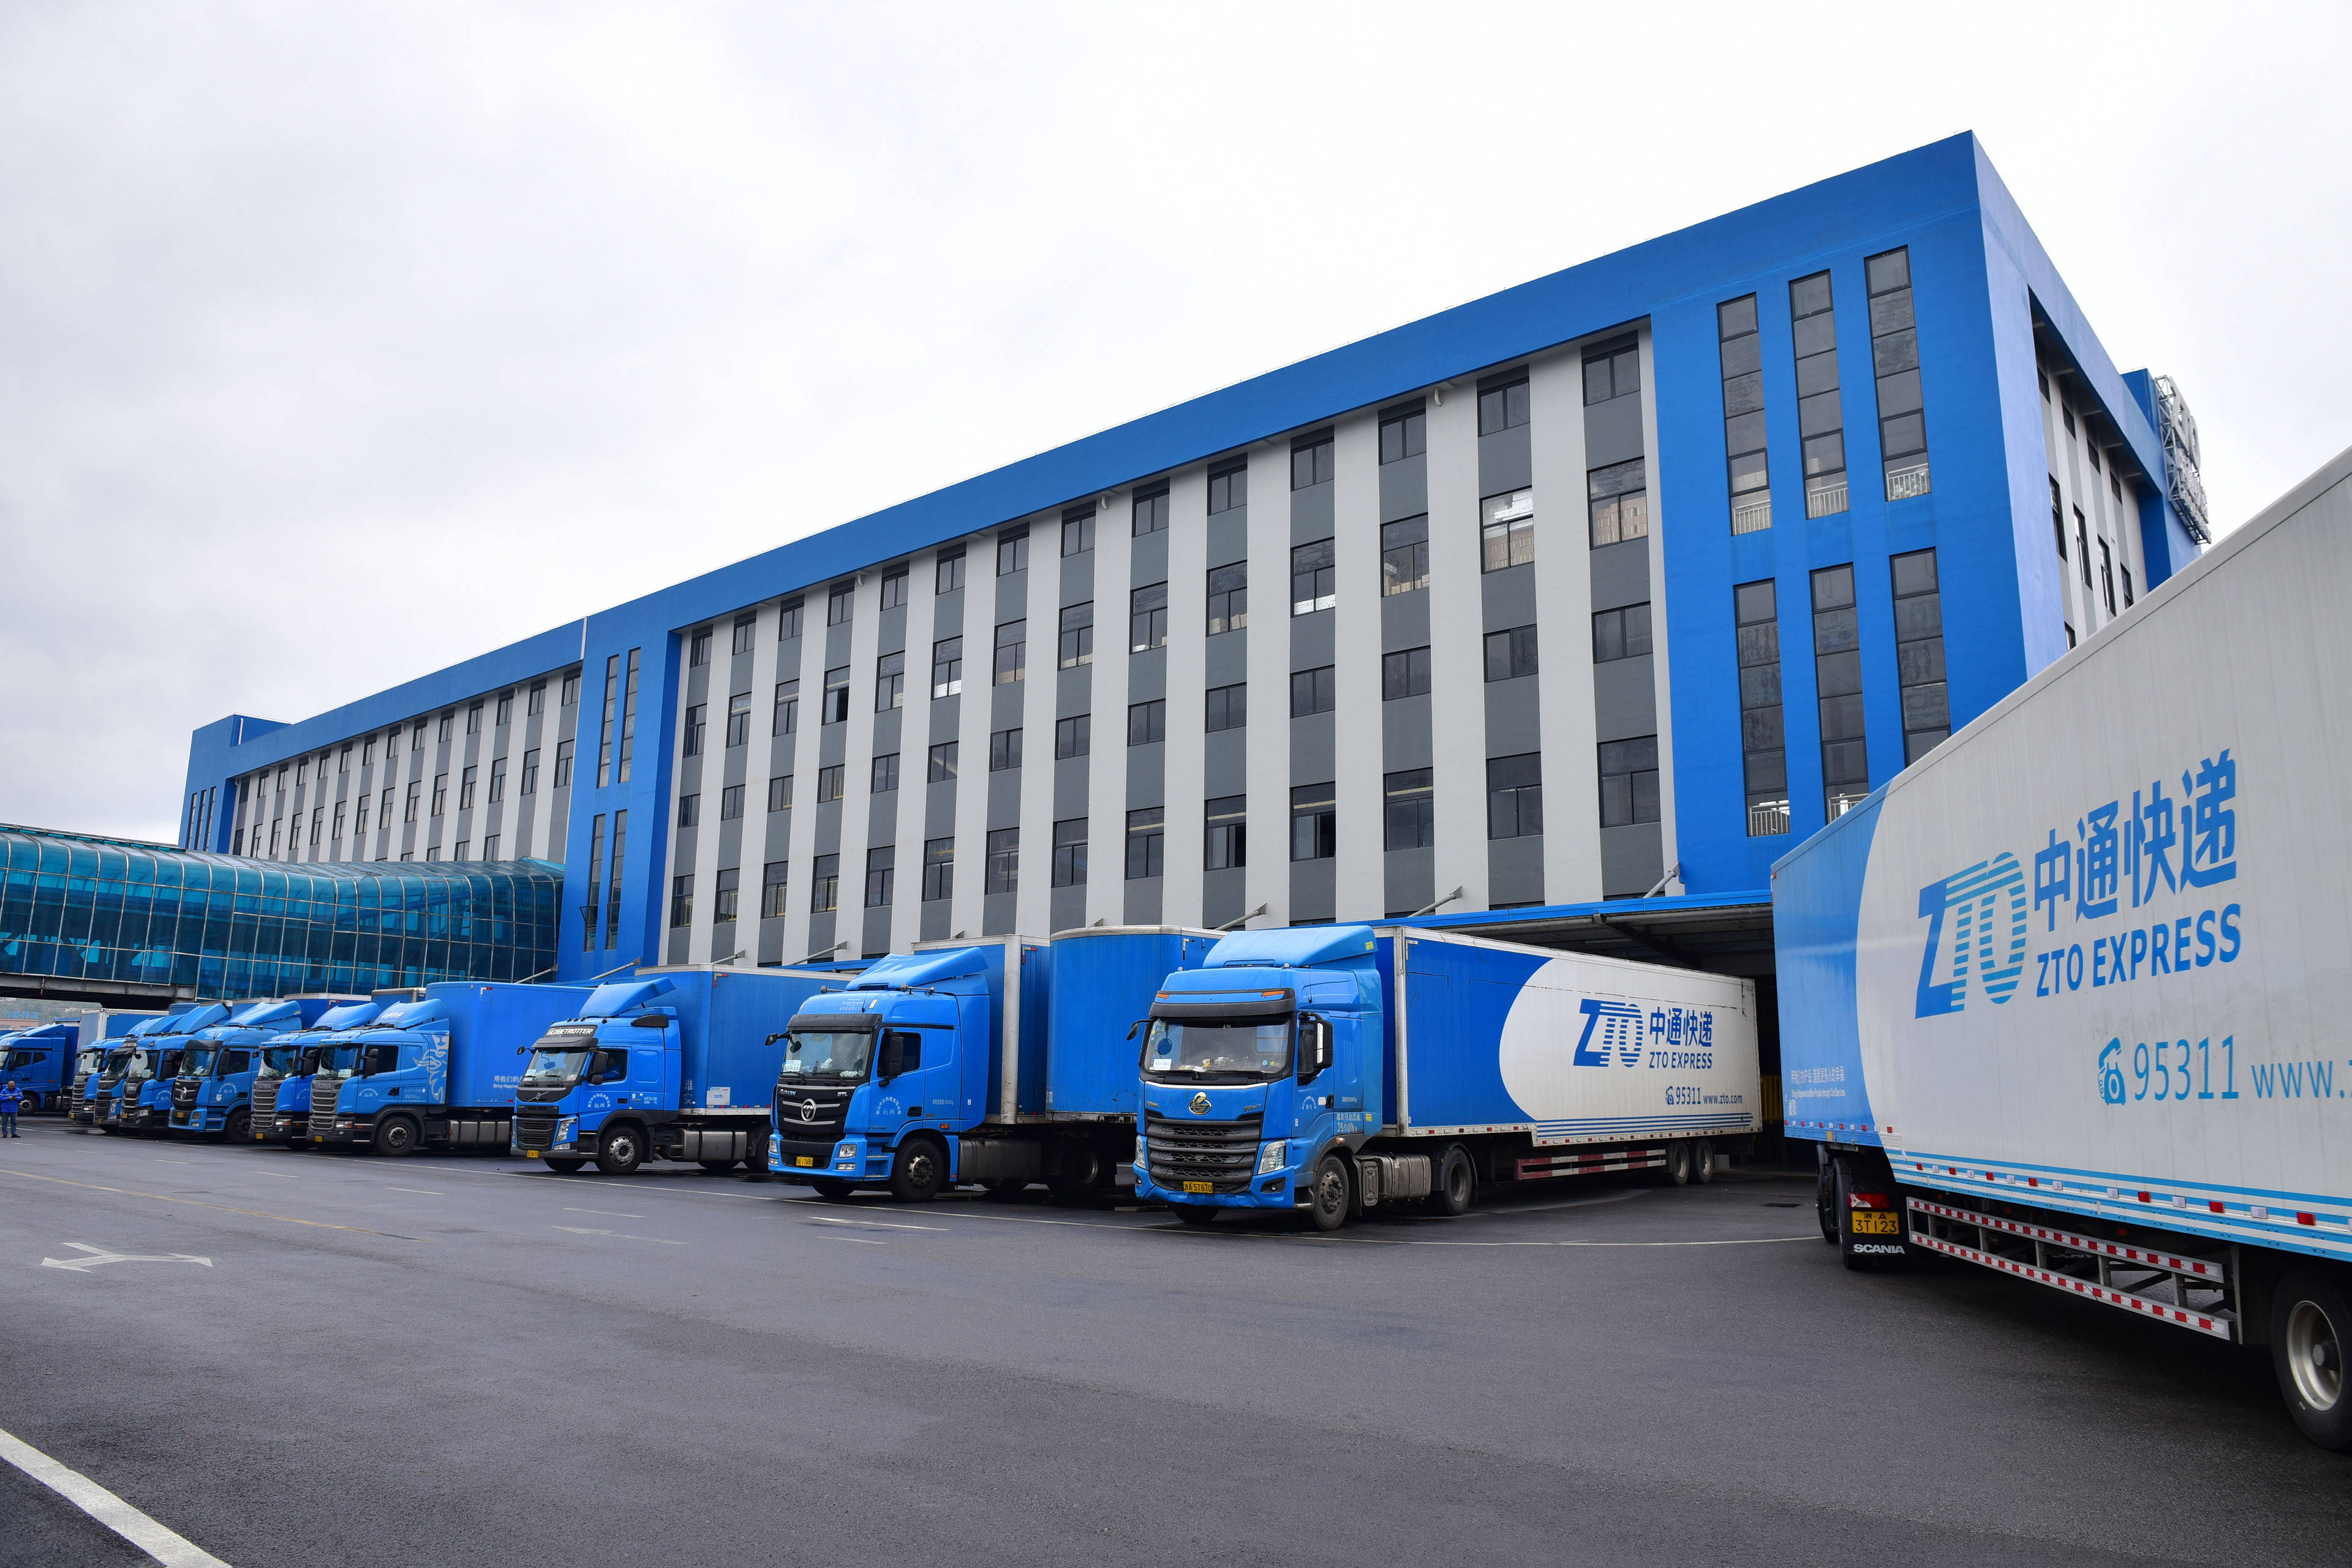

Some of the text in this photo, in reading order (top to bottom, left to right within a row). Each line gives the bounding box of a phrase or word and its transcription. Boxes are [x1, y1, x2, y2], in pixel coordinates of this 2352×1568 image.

[2034, 748, 2237, 932] 中通快递
[1915, 852, 2027, 1019] ZTO
[2037, 903, 2241, 998] ZTO EXPRESS
[1573, 998, 1643, 1068] ZTO
[1649, 1006, 1713, 1047] 中通快递
[1649, 1052, 1713, 1069] ZTO EXPRESS
[2134, 1035, 2239, 1101] 95311
[1676, 1087, 1743, 1104] 95311 www.zto.com
[1853, 1243, 1905, 1254] SCANIA
[1855, 1219, 1897, 1232] 3T123
